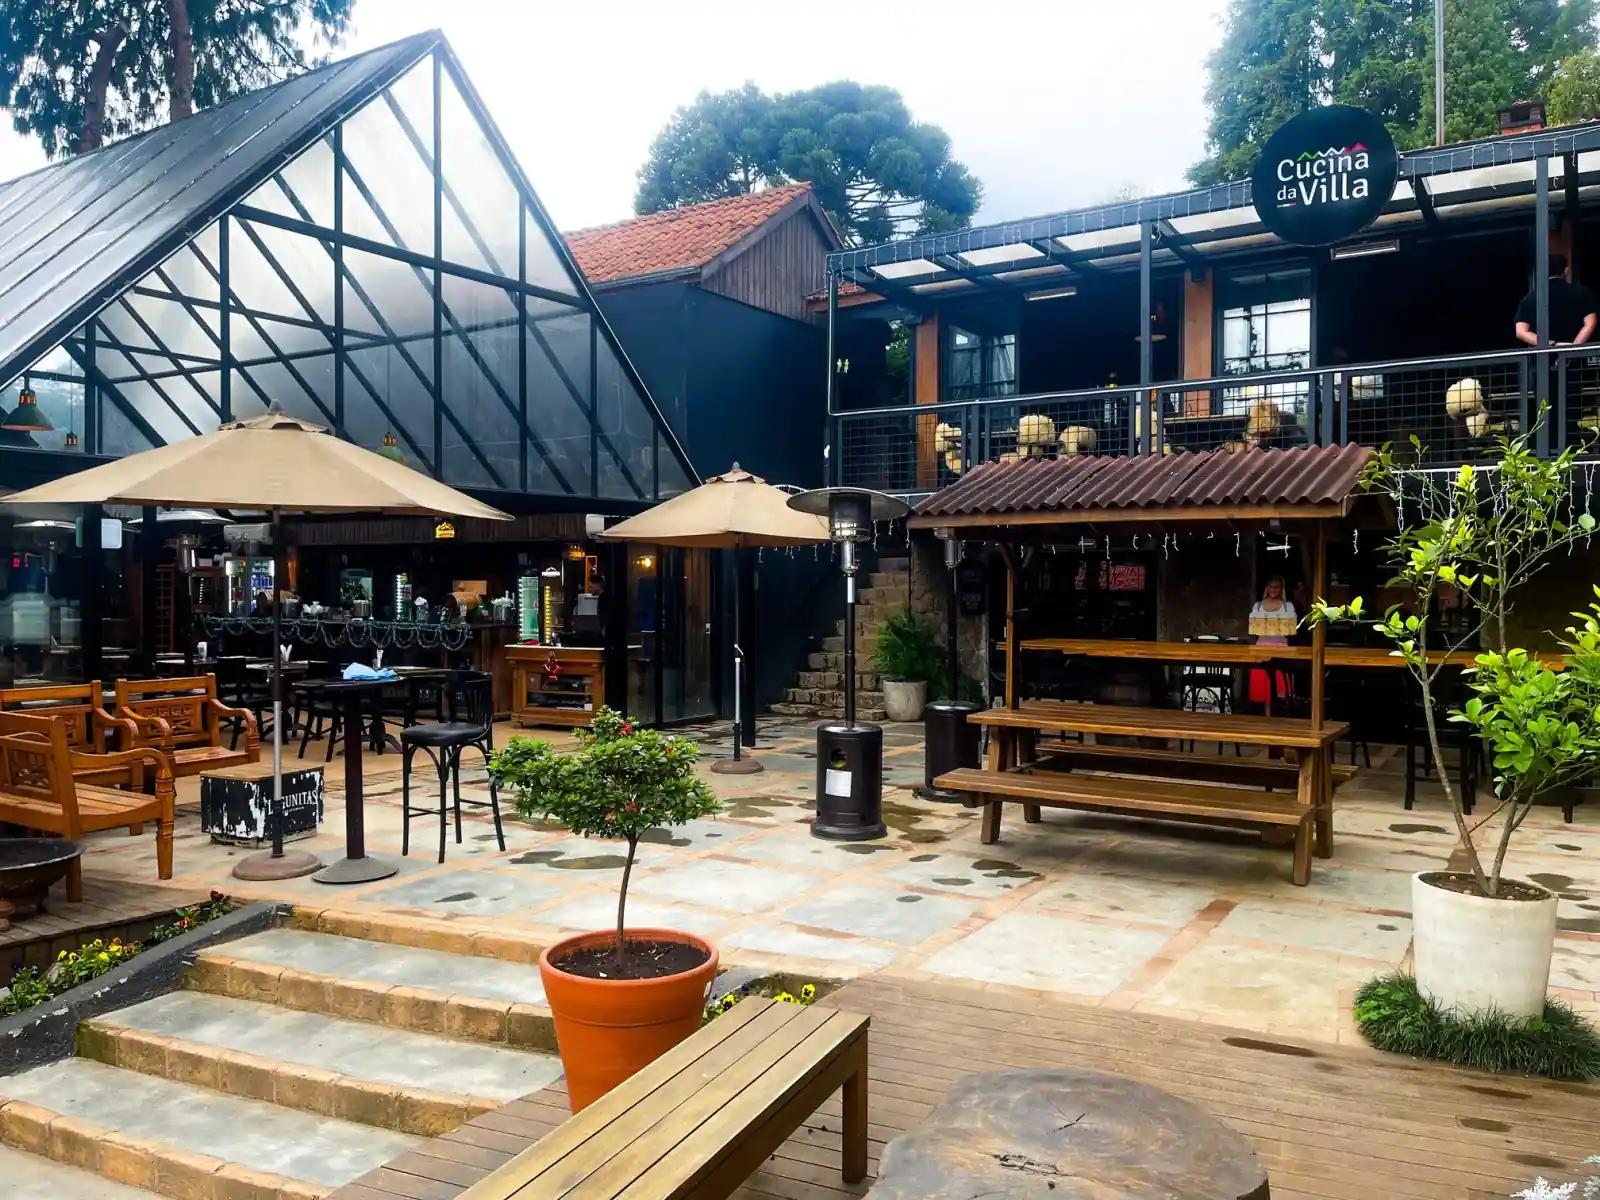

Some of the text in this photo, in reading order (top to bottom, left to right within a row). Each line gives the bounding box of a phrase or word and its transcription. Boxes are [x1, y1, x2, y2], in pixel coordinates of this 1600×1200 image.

[1277, 151, 1369, 182] Cucina
[1277, 173, 1369, 206] da Villa
[267, 790, 317, 815] LGUNITAS
